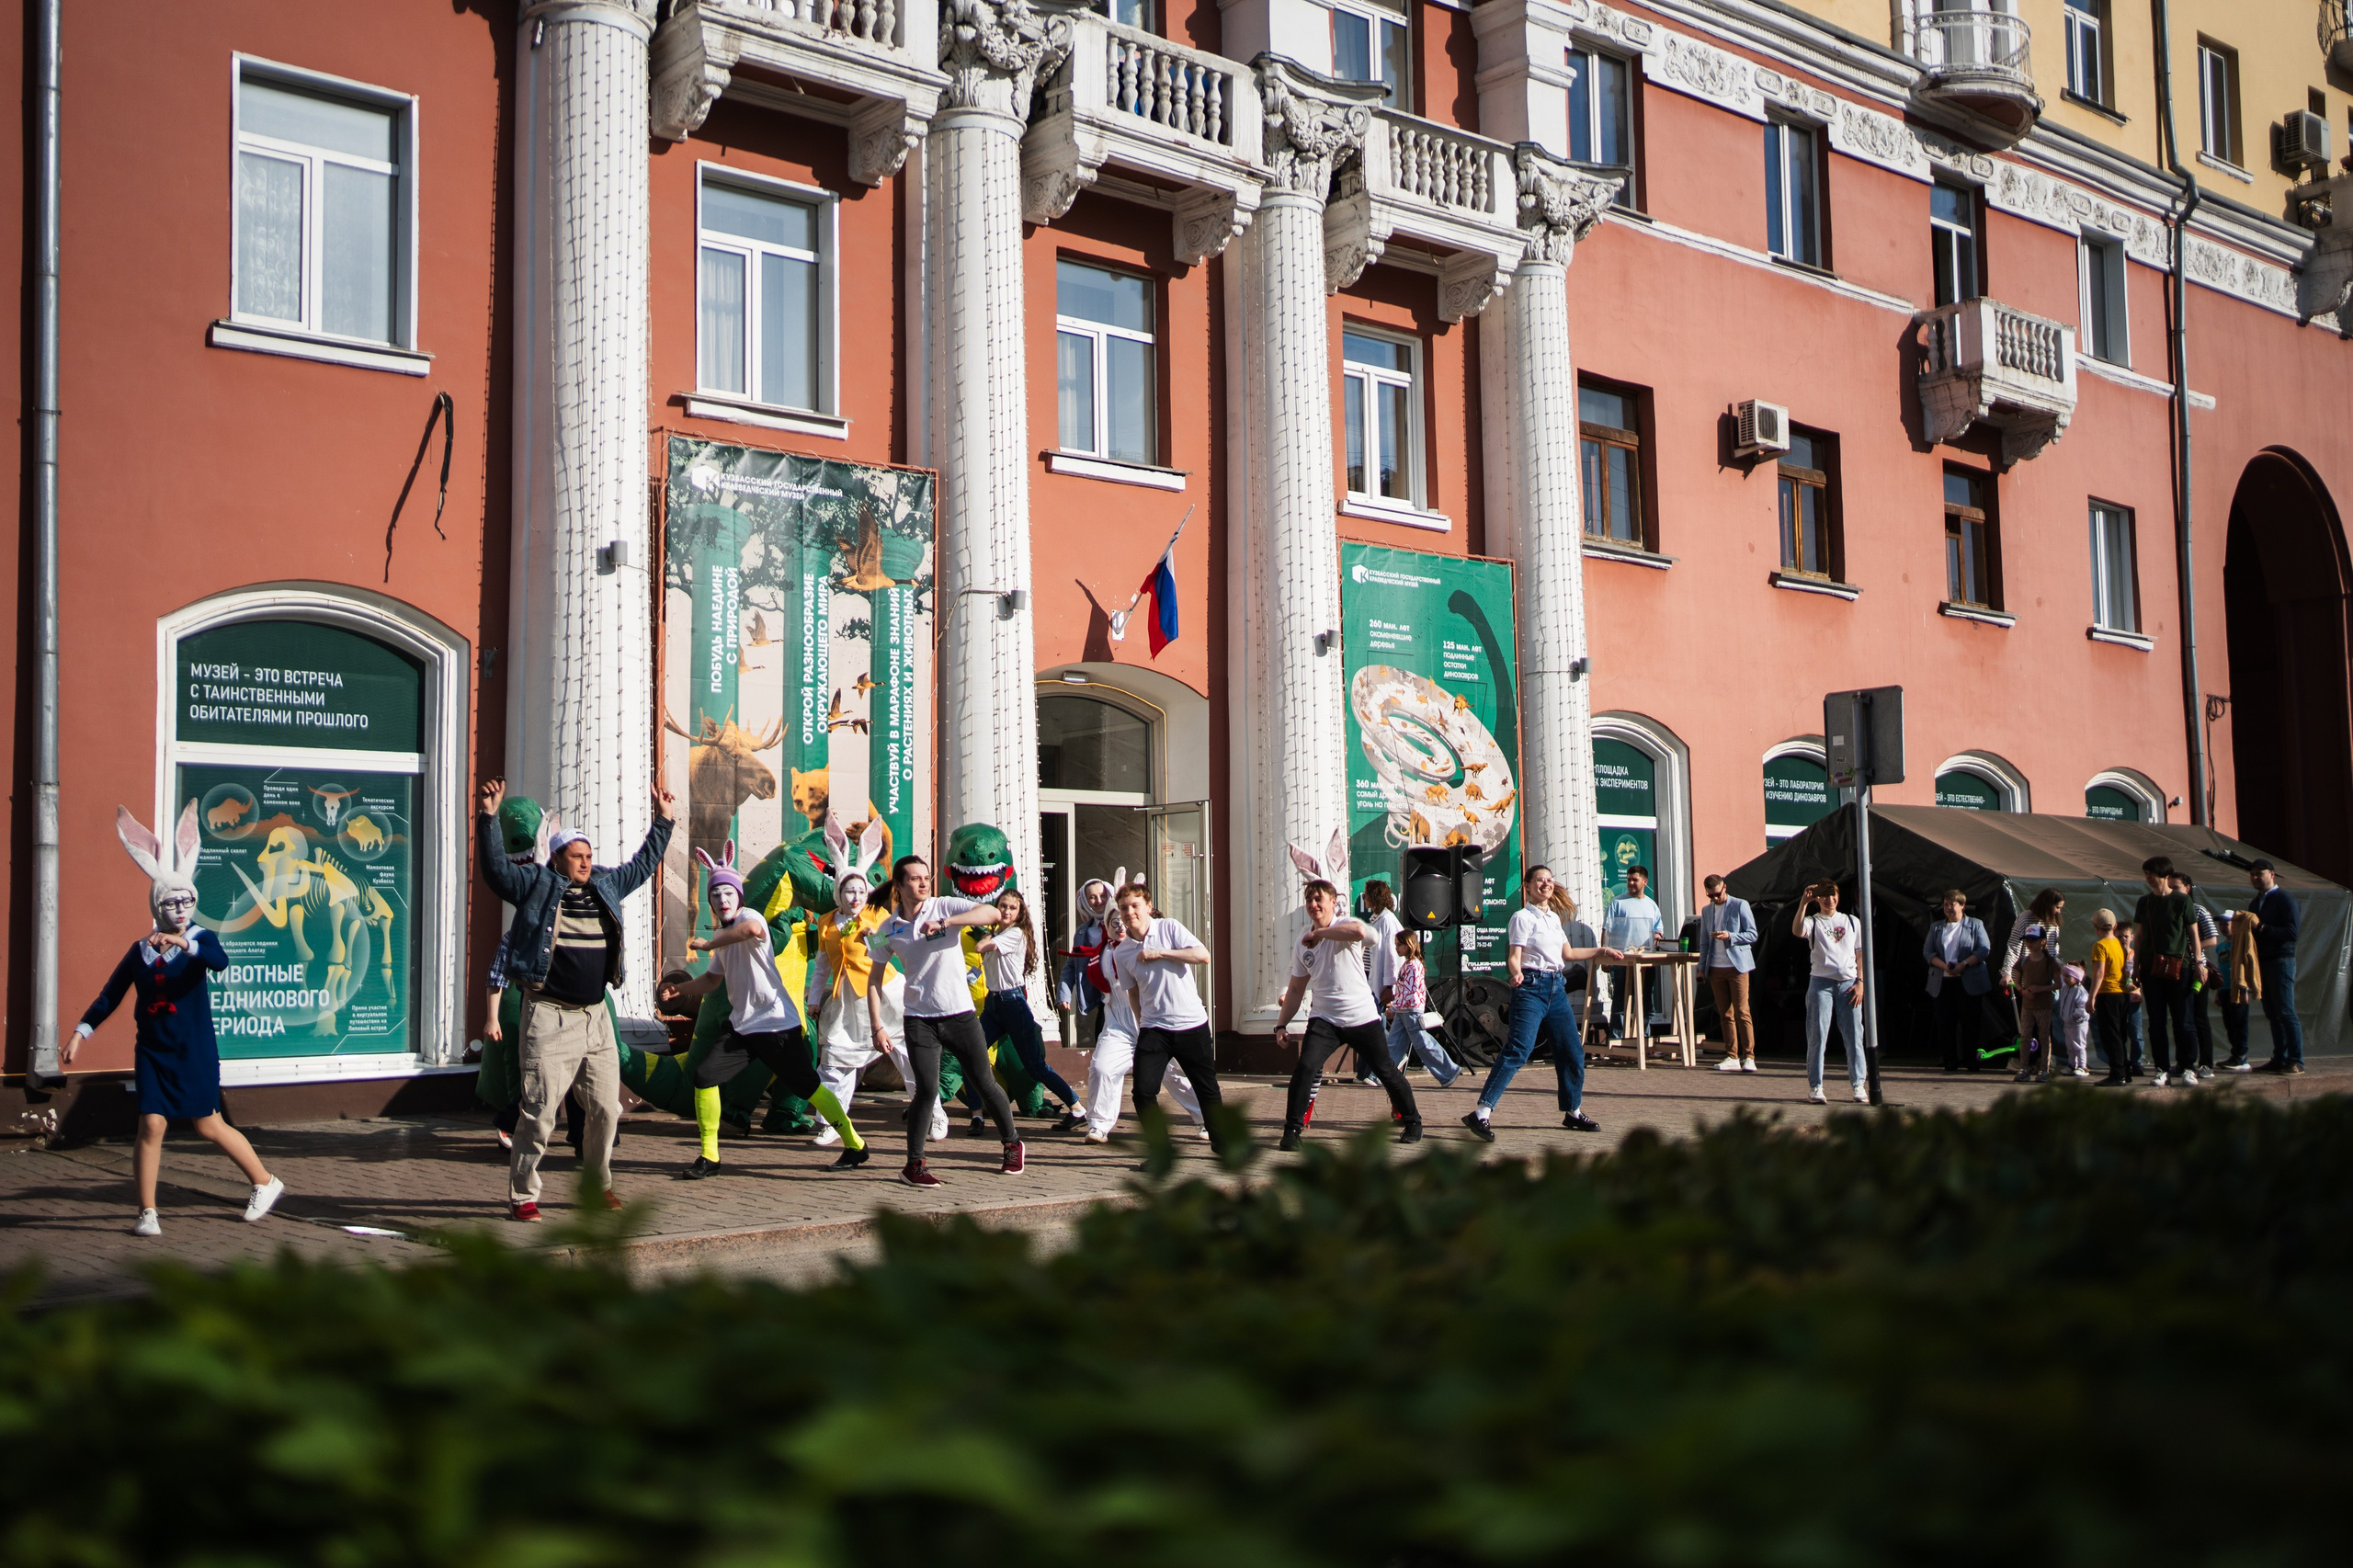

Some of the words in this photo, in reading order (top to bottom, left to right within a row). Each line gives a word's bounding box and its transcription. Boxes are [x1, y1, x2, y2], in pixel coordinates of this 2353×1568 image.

[721, 482, 780, 496] КРАЕВЕДЧЕСКИЙ
[781, 489, 805, 499] МУЗЕЙ
[722, 472, 773, 487] КУЗБАССКИЙ
[774, 481, 843, 497] ГОСУДАРСТВЕННЫЙ
[1400, 574, 1441, 585] ГОСУДАРСТВЕННЫЙ
[711, 565, 723, 632] НАЕДИНЕ
[817, 575, 828, 616] МИРА
[724, 567, 738, 649] ПРИРОДОЙ
[888, 587, 900, 644] ЗНАНИЙ
[802, 573, 814, 683] РАЗНООБРАЗИЕ
[904, 588, 914, 668] ЖИВОТНЫХ
[1370, 619, 1381, 629] 260
[1383, 622, 1398, 631] млн.
[1370, 631, 1413, 642] окаменевшие
[1370, 640, 1395, 649] деревья
[1442, 641, 1455, 650] 125
[726, 652, 737, 665] С
[1443, 652, 1475, 661] подлинные
[710, 636, 723, 693] ПОБУДЬ
[1443, 661, 1467, 669] остатки
[190, 663, 239, 680] МУЗЕЙ
[255, 667, 279, 683] ЭТО
[284, 669, 344, 687] ВСТРЕЧА
[816, 619, 829, 734] ОКРУЖАЮЩЕГО
[904, 671, 914, 682] И
[1443, 670, 1479, 680] динозавров
[890, 648, 900, 726] МАРАФОНЕ
[190, 684, 199, 699] С
[203, 684, 325, 706] ТАИНСТВЕННЫМИ
[189, 704, 292, 724] ОБИТАТЕЛЯМИ
[296, 710, 369, 729] ПРОШЛОГО
[801, 685, 814, 745] ОТКРОЙ
[903, 685, 914, 767] РАСТЕНИЯХ
[890, 730, 900, 740] В
[903, 769, 913, 780] О
[1595, 764, 1629, 777] ПЛОЩАДКА
[887, 744, 900, 815] УЧАСТВУЙ
[1356, 779, 1370, 789] 360
[1600, 778, 1648, 790] ЭКСПЕРИМЕНТОВ
[1763, 777, 1775, 788] ЗЕЙ
[1779, 778, 1789, 789] ЭТО
[1790, 779, 1824, 790] ЛАБОРАТОРИЯ
[362, 796, 395, 804] Тематические
[1356, 790, 1378, 799] самый
[1765, 790, 1793, 801] ИЗУЧЕНИЮ
[1794, 791, 1827, 802] ДИНОЗАВРОВ
[1935, 791, 1944, 801] ЗЕЙ
[1356, 800, 1374, 809] уголь
[199, 846, 229, 855] Подлинный
[208, 989, 330, 1012] ЕДНИКОВОГО
[211, 1016, 286, 1037] ЕРИОДА
